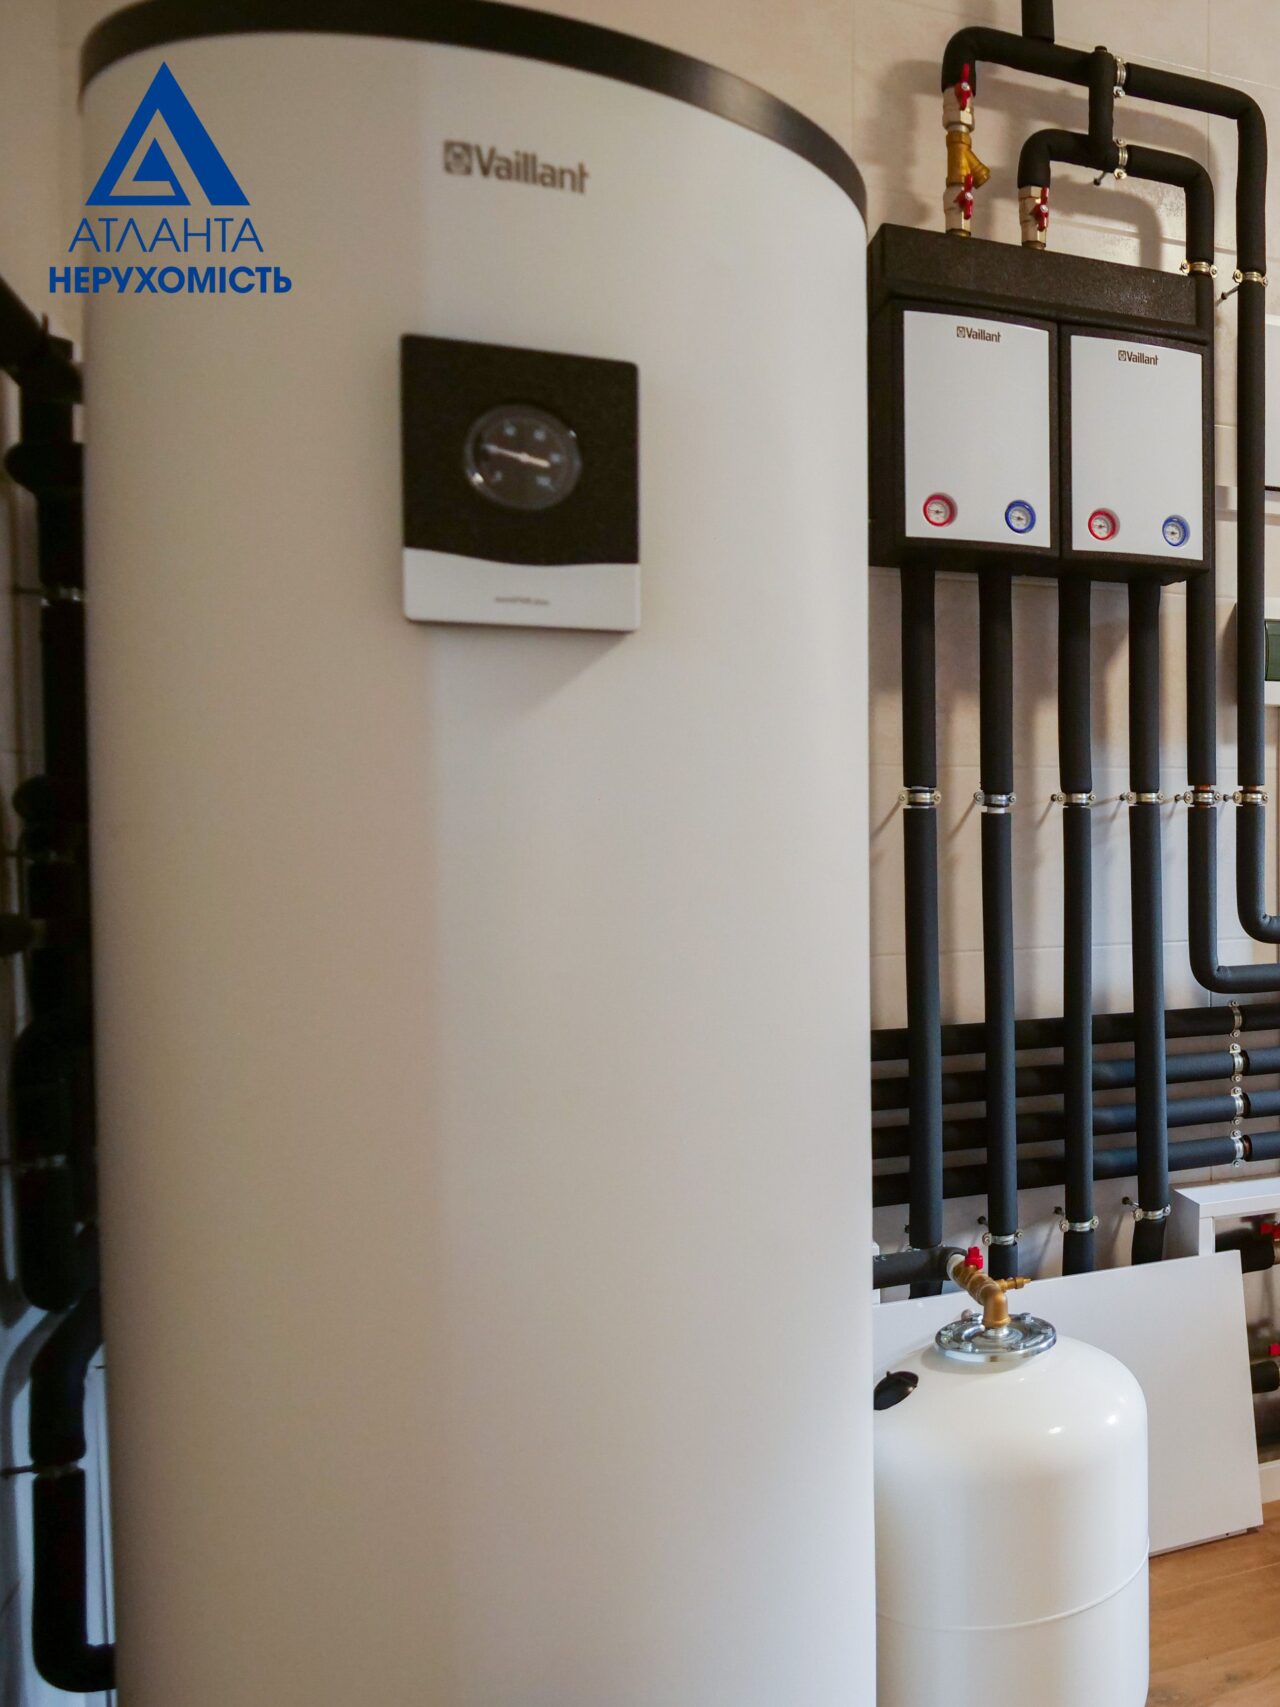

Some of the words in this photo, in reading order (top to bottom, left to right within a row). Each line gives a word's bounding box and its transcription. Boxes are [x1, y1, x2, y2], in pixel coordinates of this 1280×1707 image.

[474, 144, 590, 194] Vaillant
[965, 326, 1002, 343] Vaillant
[1126, 350, 1159, 366] Vaillant
